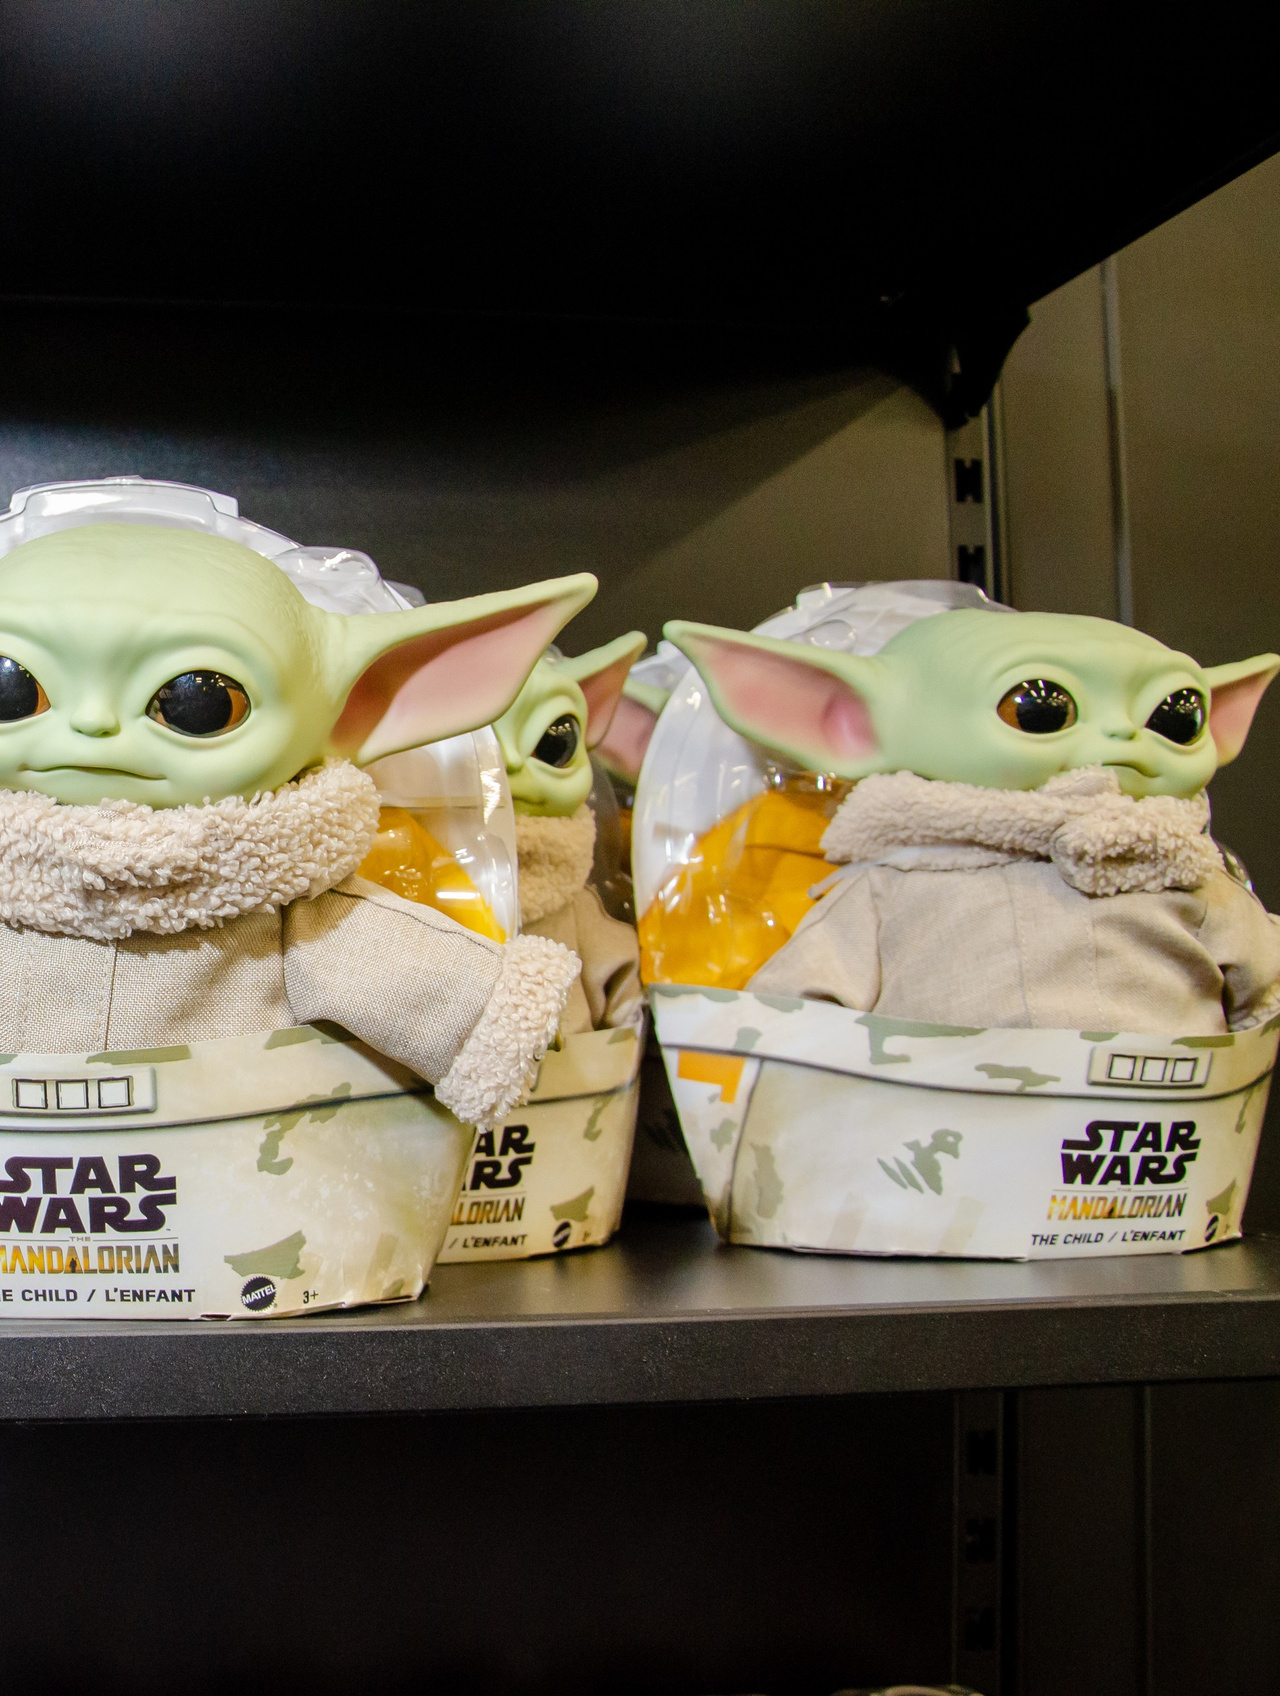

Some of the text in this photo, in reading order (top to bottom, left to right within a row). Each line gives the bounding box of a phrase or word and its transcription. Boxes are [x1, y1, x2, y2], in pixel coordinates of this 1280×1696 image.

[473, 1124, 536, 1157] AR
[1061, 1120, 1201, 1152] STAR
[462, 1155, 533, 1191] RS
[1061, 1151, 1197, 1185] WARS
[450, 1197, 525, 1226] LORIAN
[1046, 1192, 1187, 1221] MANDALORIAN
[462, 1234, 528, 1249] L'ENFANT
[1031, 1234, 1059, 1246] THE
[1063, 1232, 1104, 1244] CHILD
[1121, 1230, 1186, 1243] L'ENFANT
[21, 1289, 78, 1302] CHILD
[105, 1287, 196, 1303] L'ENFANT
[242, 1284, 276, 1304] MATTEL
[303, 1290, 319, 1304] 3+
